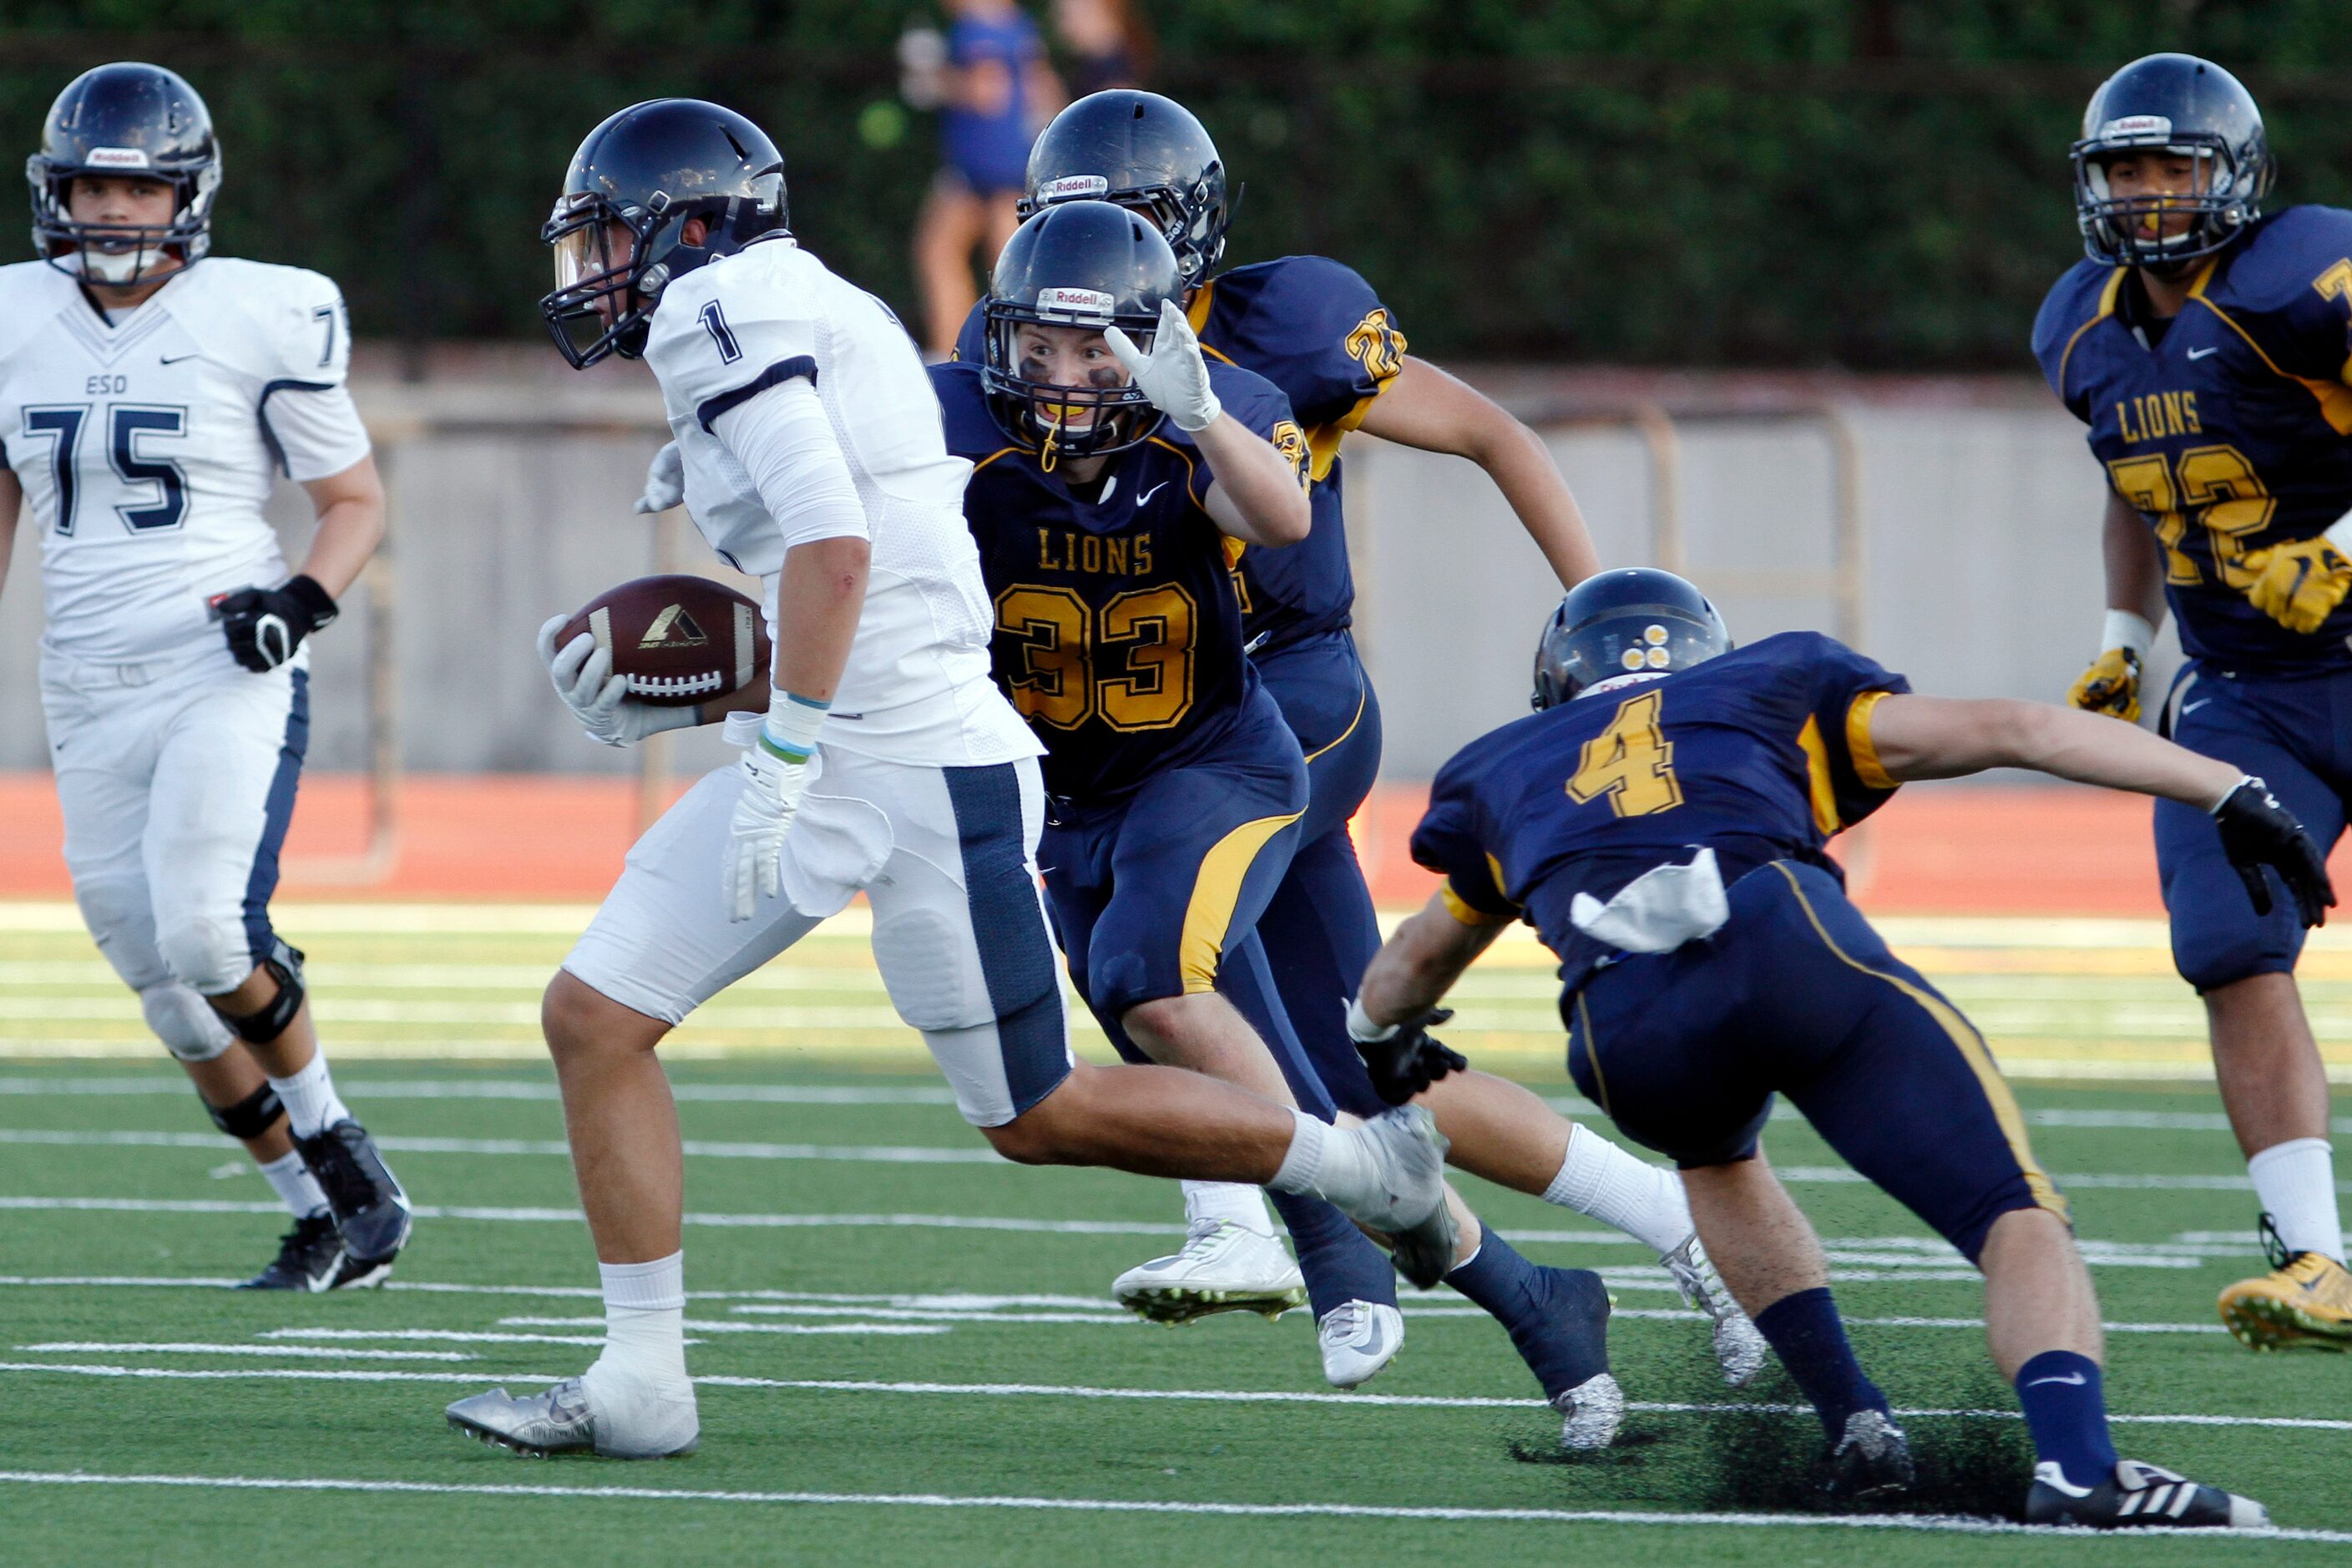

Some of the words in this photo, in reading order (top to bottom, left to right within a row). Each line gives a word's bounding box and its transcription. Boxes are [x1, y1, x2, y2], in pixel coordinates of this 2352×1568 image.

[1056, 178, 1092, 193] Riddell
[696, 298, 743, 366] 1
[1056, 291, 1098, 306] Riddell
[2116, 390, 2203, 444] LIONS
[22, 402, 191, 537] 75
[2107, 443, 2278, 590] 72
[1038, 527, 1153, 576] LIONS
[994, 581, 1197, 732] 33
[1565, 688, 1684, 817] 4
